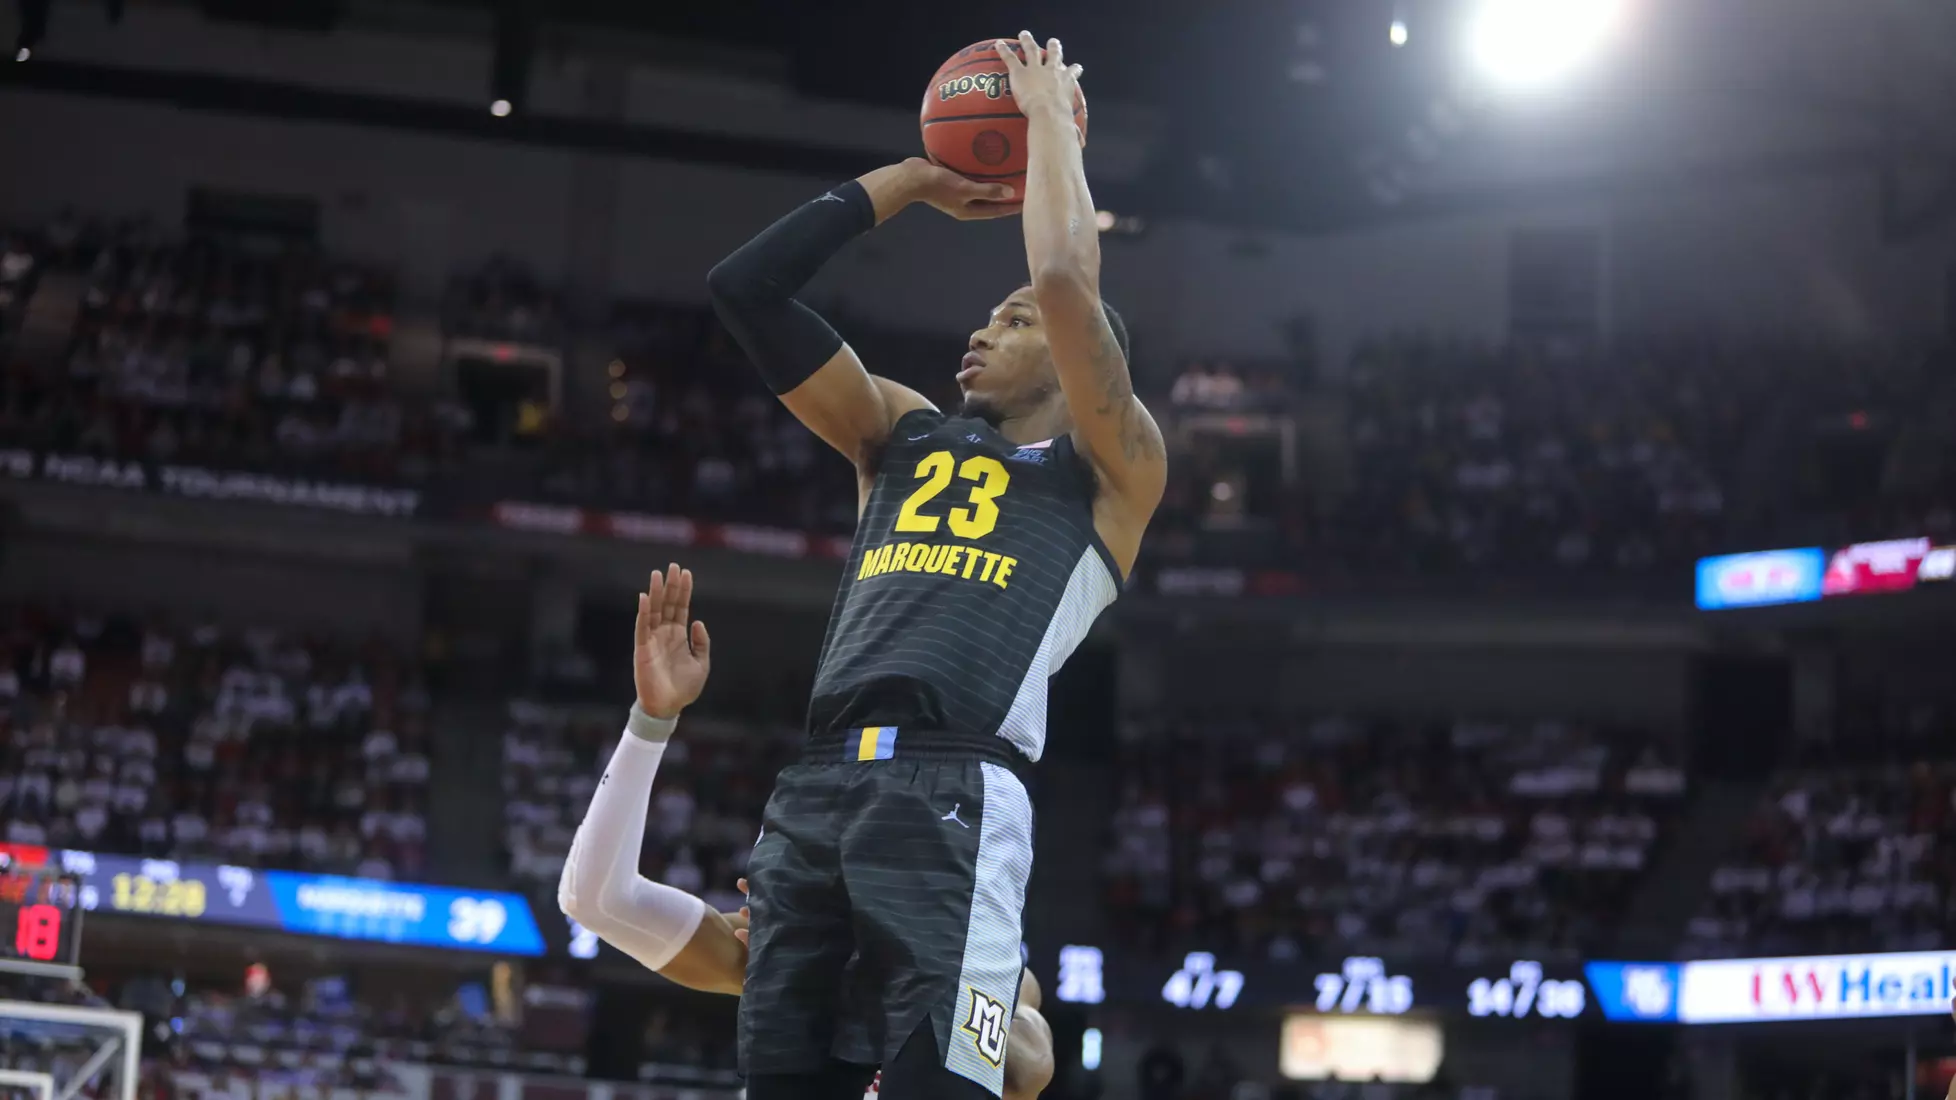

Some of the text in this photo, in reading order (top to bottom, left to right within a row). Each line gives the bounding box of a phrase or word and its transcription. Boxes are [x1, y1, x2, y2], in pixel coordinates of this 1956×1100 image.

[895, 451, 1010, 539] 23
[857, 542, 1018, 589] MARQUETTE
[16, 904, 61, 959] 18
[960, 986, 1007, 1069] MU
